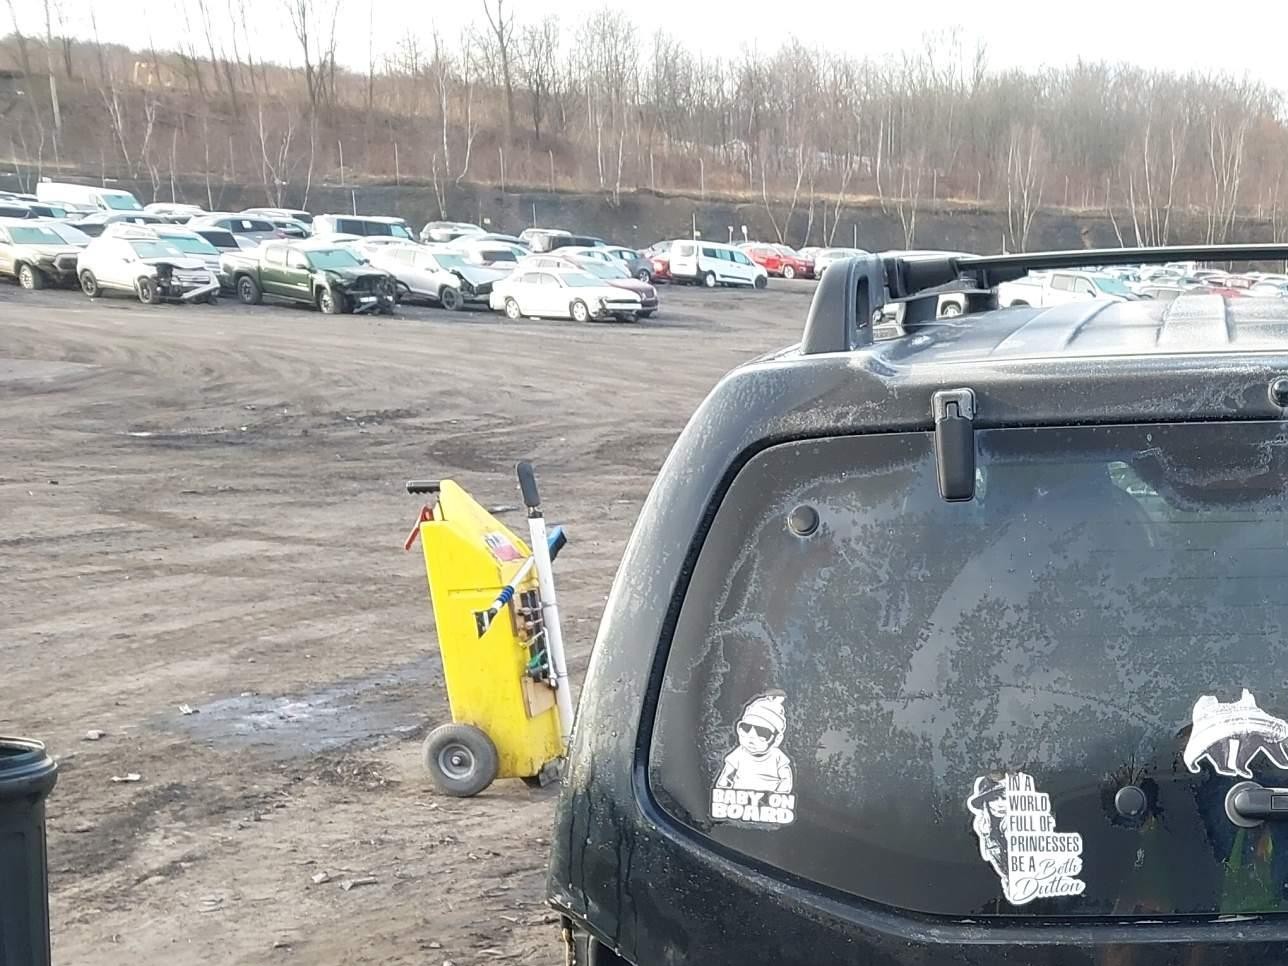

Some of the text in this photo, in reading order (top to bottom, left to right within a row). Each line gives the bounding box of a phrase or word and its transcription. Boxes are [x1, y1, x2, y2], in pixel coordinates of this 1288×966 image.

[1009, 775, 1032, 791] IN A
[713, 788, 796, 810] BABY ON
[1008, 794, 1048, 812] WORLD
[711, 802, 795, 824] BOARD
[1009, 815, 1053, 832] FULL OF
[1010, 835, 1080, 852] PRINCESSES
[1011, 856, 1026, 872] BE
[1028, 856, 1036, 872] A
[1013, 876, 1080, 902] Dutton
